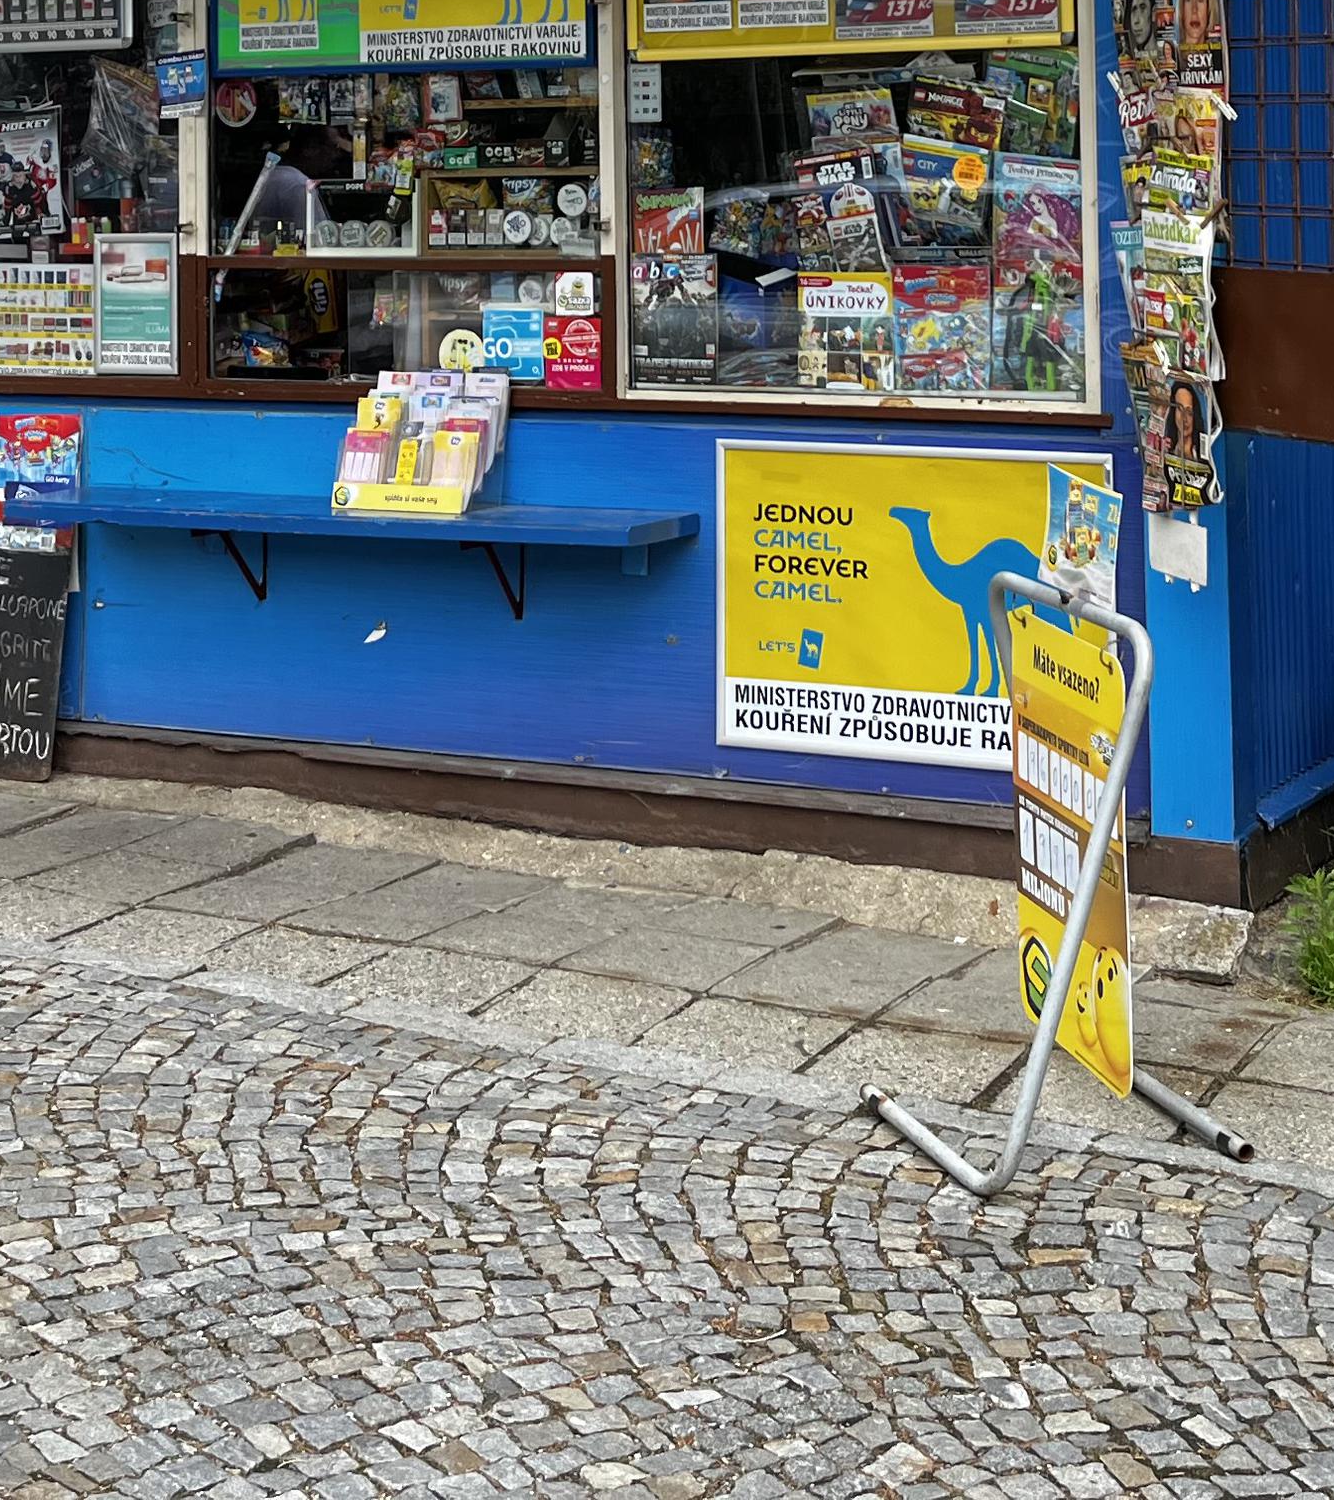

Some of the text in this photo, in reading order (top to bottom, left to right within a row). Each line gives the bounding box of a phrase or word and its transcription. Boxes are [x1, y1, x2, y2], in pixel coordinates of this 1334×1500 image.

[887, 0, 932, 17] 131 Kč
[367, 24, 581, 46] MINISTERSTVO ZDRAVOTNICTVÍ VARUJE:
[367, 41, 581, 62] KOUŘENÍ ZPŮSOBUJE RAKOVINU
[1187, 52, 1213, 68] SEXY
[1181, 67, 1223, 85] KŘIVKÁM
[0, 118, 51, 133] HOCKEY
[485, 146, 512, 157] OCB
[819, 161, 855, 174] STAR
[917, 159, 938, 170] CITY
[345, 182, 365, 191] DOPE
[817, 172, 856, 185] WARS
[1150, 168, 1196, 194] Zahrada
[805, 288, 886, 311] ÚNIKOVKY
[483, 337, 512, 358] GO
[753, 503, 854, 526] JEDNOU
[754, 529, 843, 554] CAMEL,
[754, 554, 868, 579] FOREVER
[754, 580, 843, 604] CAMEL.
[759, 639, 796, 653] LET'S
[1033, 644, 1100, 704] Máte vsazeno?
[734, 683, 866, 714] MINISTERSTVO
[734, 708, 972, 748] KOUŘENÍ ZPŮSOBUJE
[1021, 866, 1065, 918] MILIONŮ
